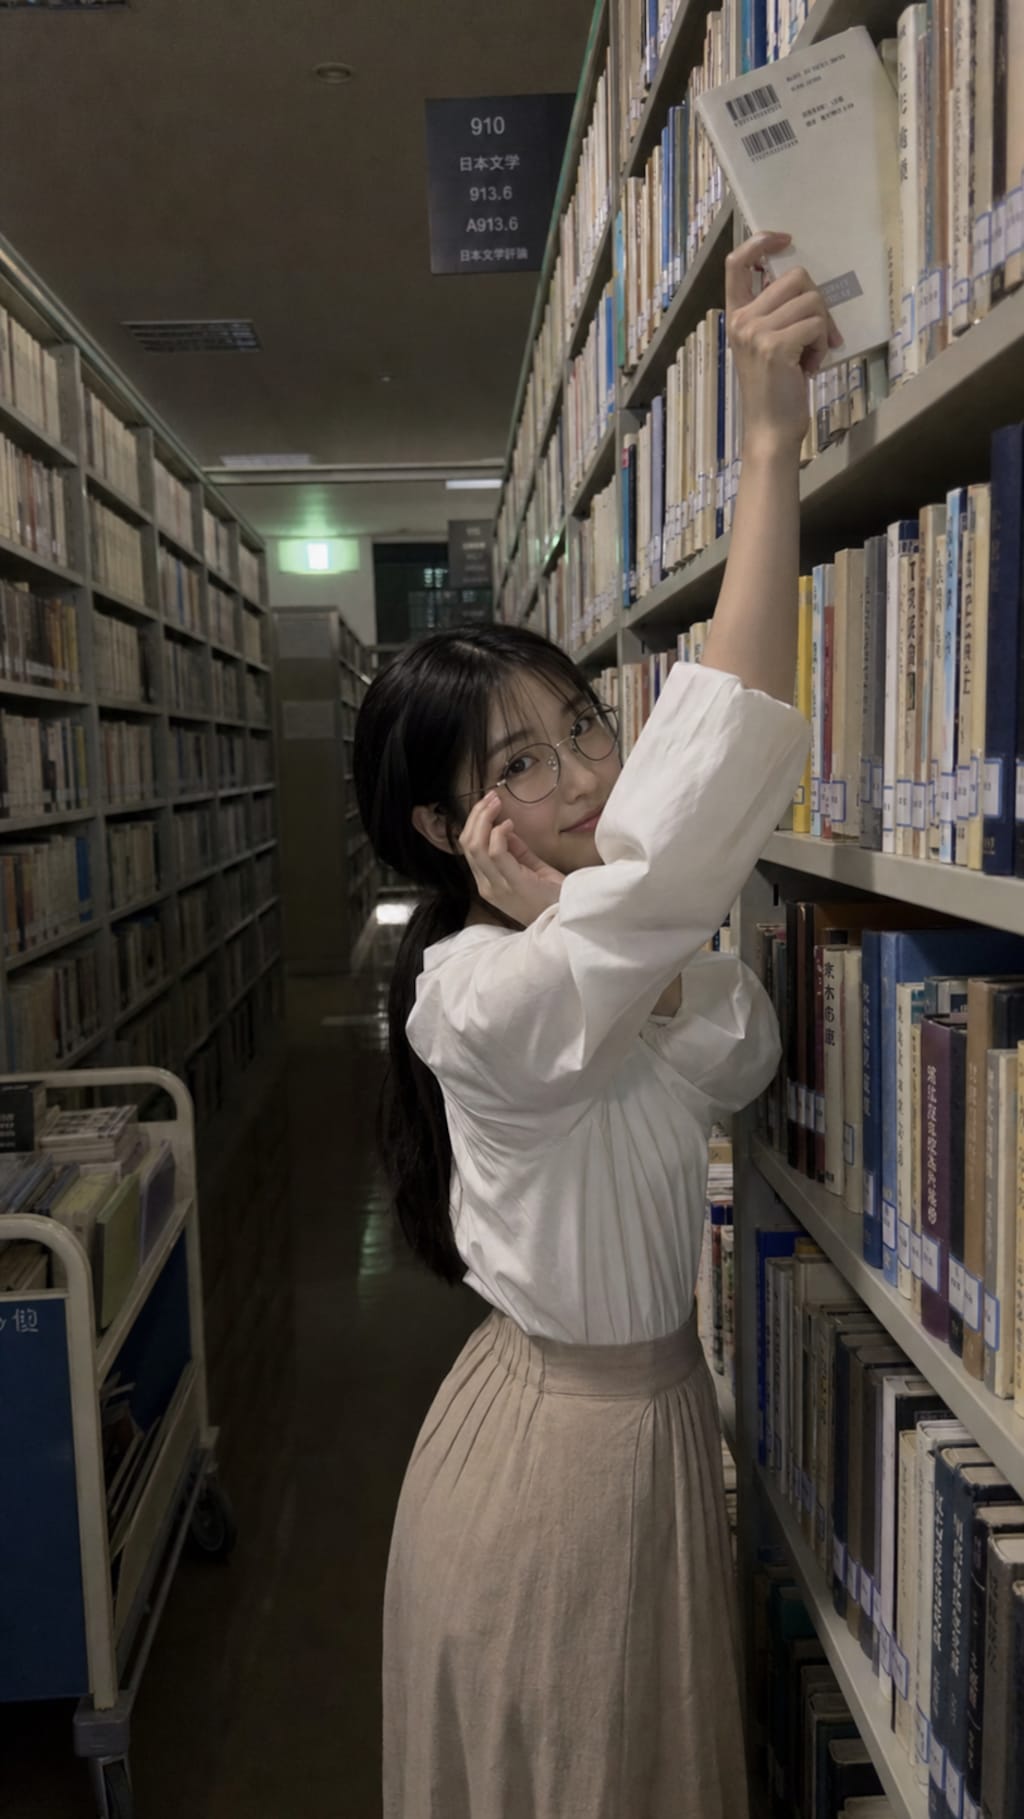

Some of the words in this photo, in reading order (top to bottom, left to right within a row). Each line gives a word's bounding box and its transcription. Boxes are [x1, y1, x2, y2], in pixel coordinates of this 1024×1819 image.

[470, 116, 505, 136] 910
[459, 154, 521, 172] 日本文学
[469, 186, 513, 202] 913.6
[465, 216, 519, 233] A913.6
[459, 247, 528, 262] 日本文学評論
